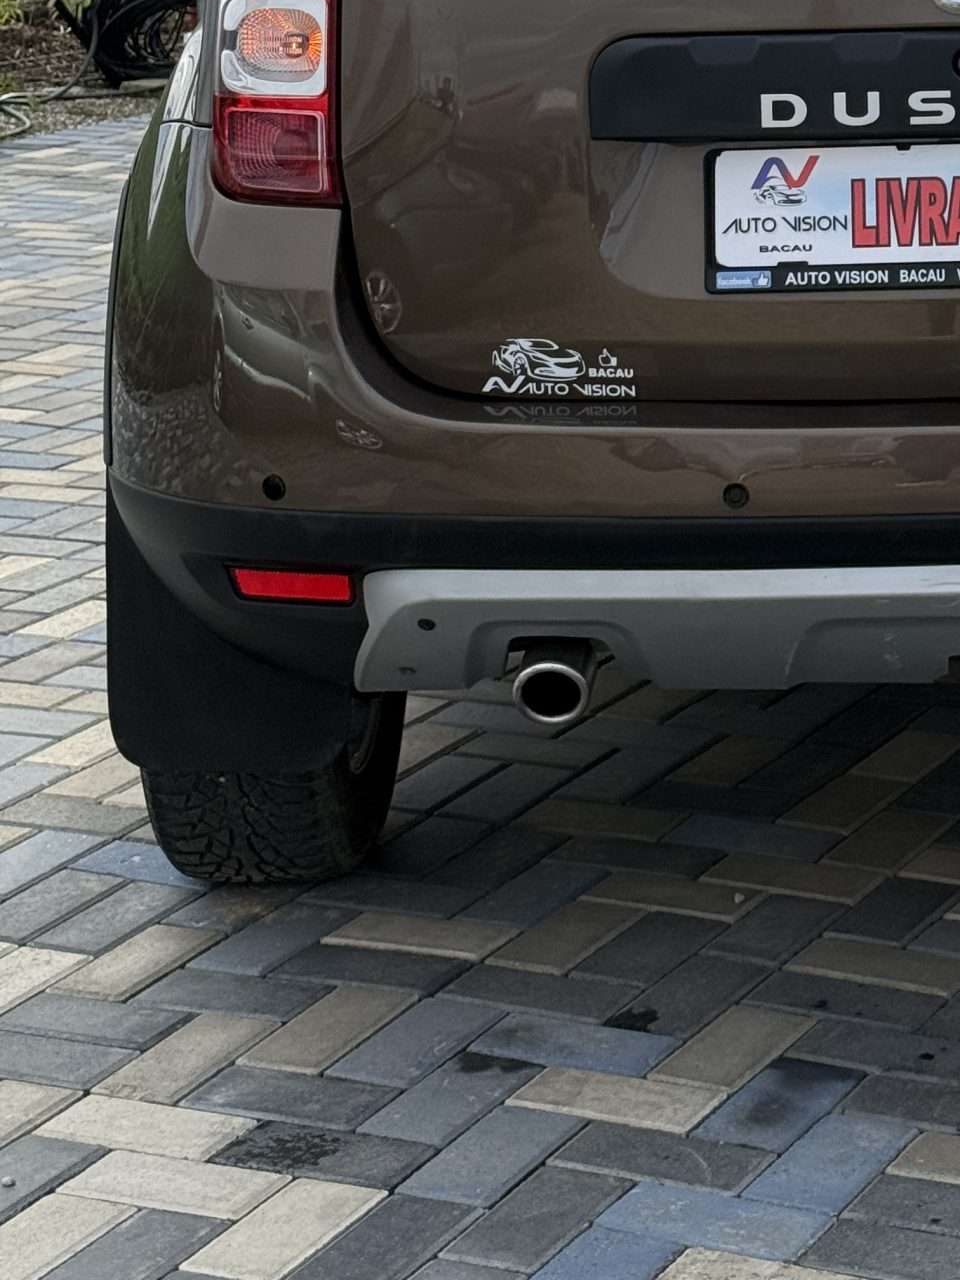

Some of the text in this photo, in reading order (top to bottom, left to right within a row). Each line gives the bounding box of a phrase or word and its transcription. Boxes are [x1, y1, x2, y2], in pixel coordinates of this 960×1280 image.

[722, 214, 849, 235] AUTO VISION
[759, 243, 813, 254] BACAU
[784, 271, 831, 286] AUTO
[835, 269, 889, 285] VISION
[899, 268, 946, 283] BACAU
[588, 367, 634, 379] BACAU
[518, 382, 570, 396] AUTO
[572, 383, 637, 397] VISION
